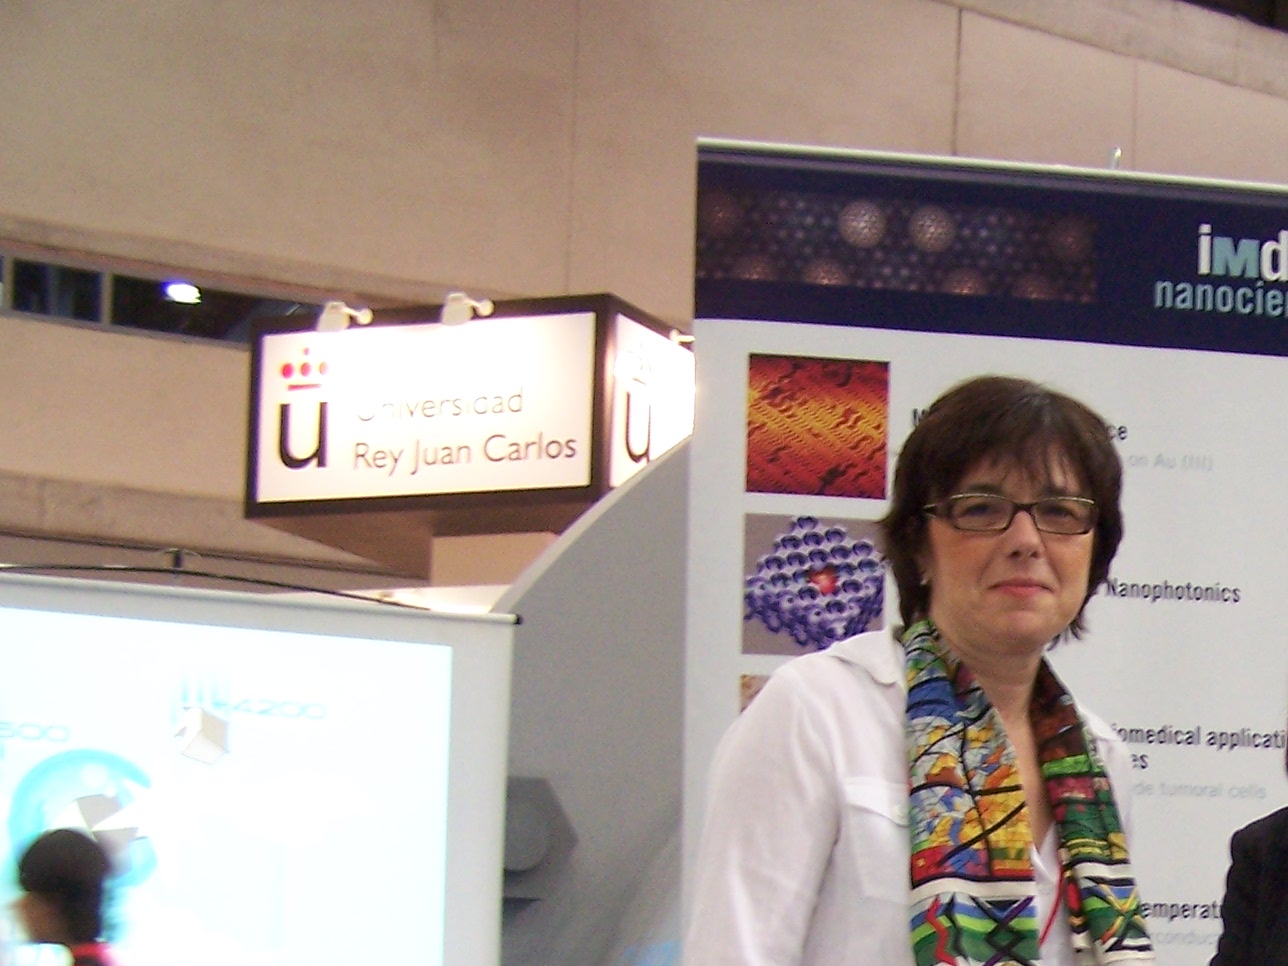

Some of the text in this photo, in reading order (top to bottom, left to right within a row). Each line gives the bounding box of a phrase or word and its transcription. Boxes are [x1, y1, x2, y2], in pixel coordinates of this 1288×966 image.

[353, 431, 578, 477] Rey Juan Carlos
[1107, 578, 1241, 603] Nanophotonics
[1140, 901, 1222, 923] emperat
